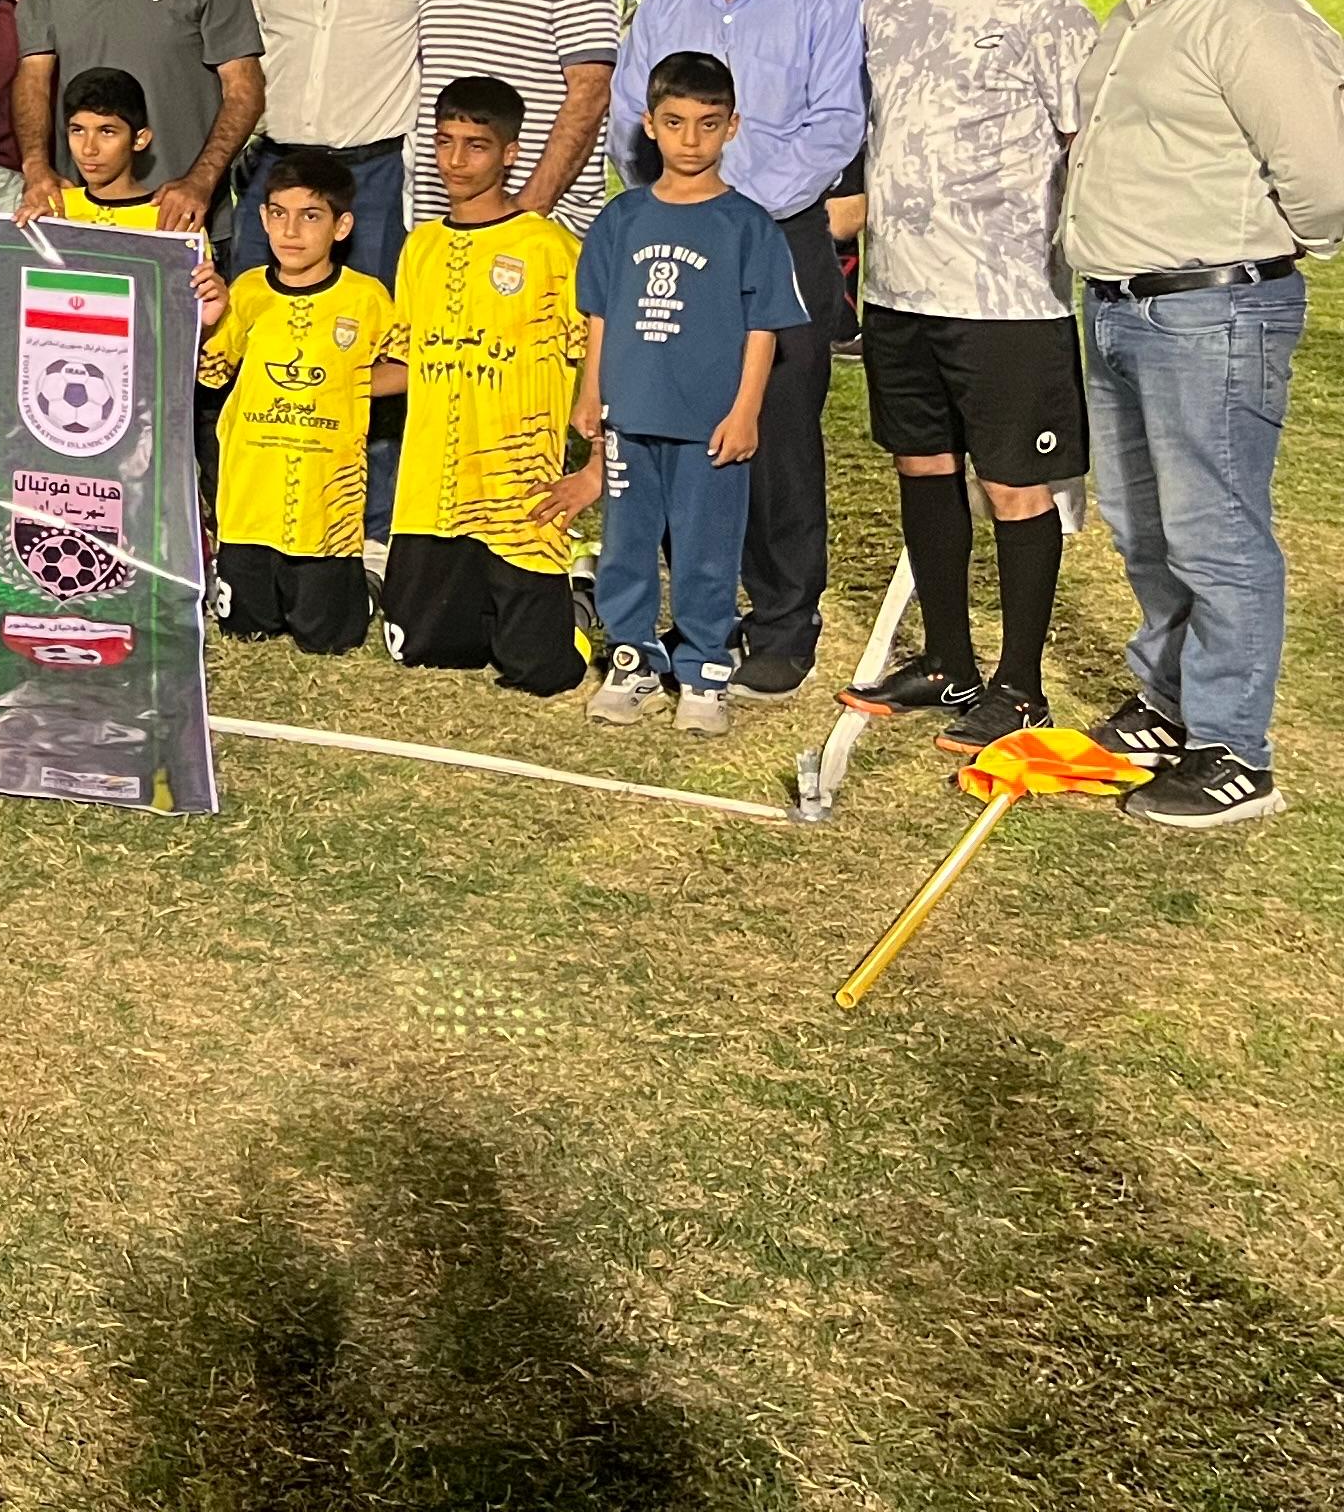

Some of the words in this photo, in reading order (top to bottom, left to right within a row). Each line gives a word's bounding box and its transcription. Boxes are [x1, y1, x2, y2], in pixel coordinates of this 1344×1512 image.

[487, 335, 516, 364] برق
[243, 411, 297, 426] VARGAAR
[299, 415, 340, 431] COFFEE
[14, 474, 71, 496] فوتبال
[75, 481, 122, 502] هیات
